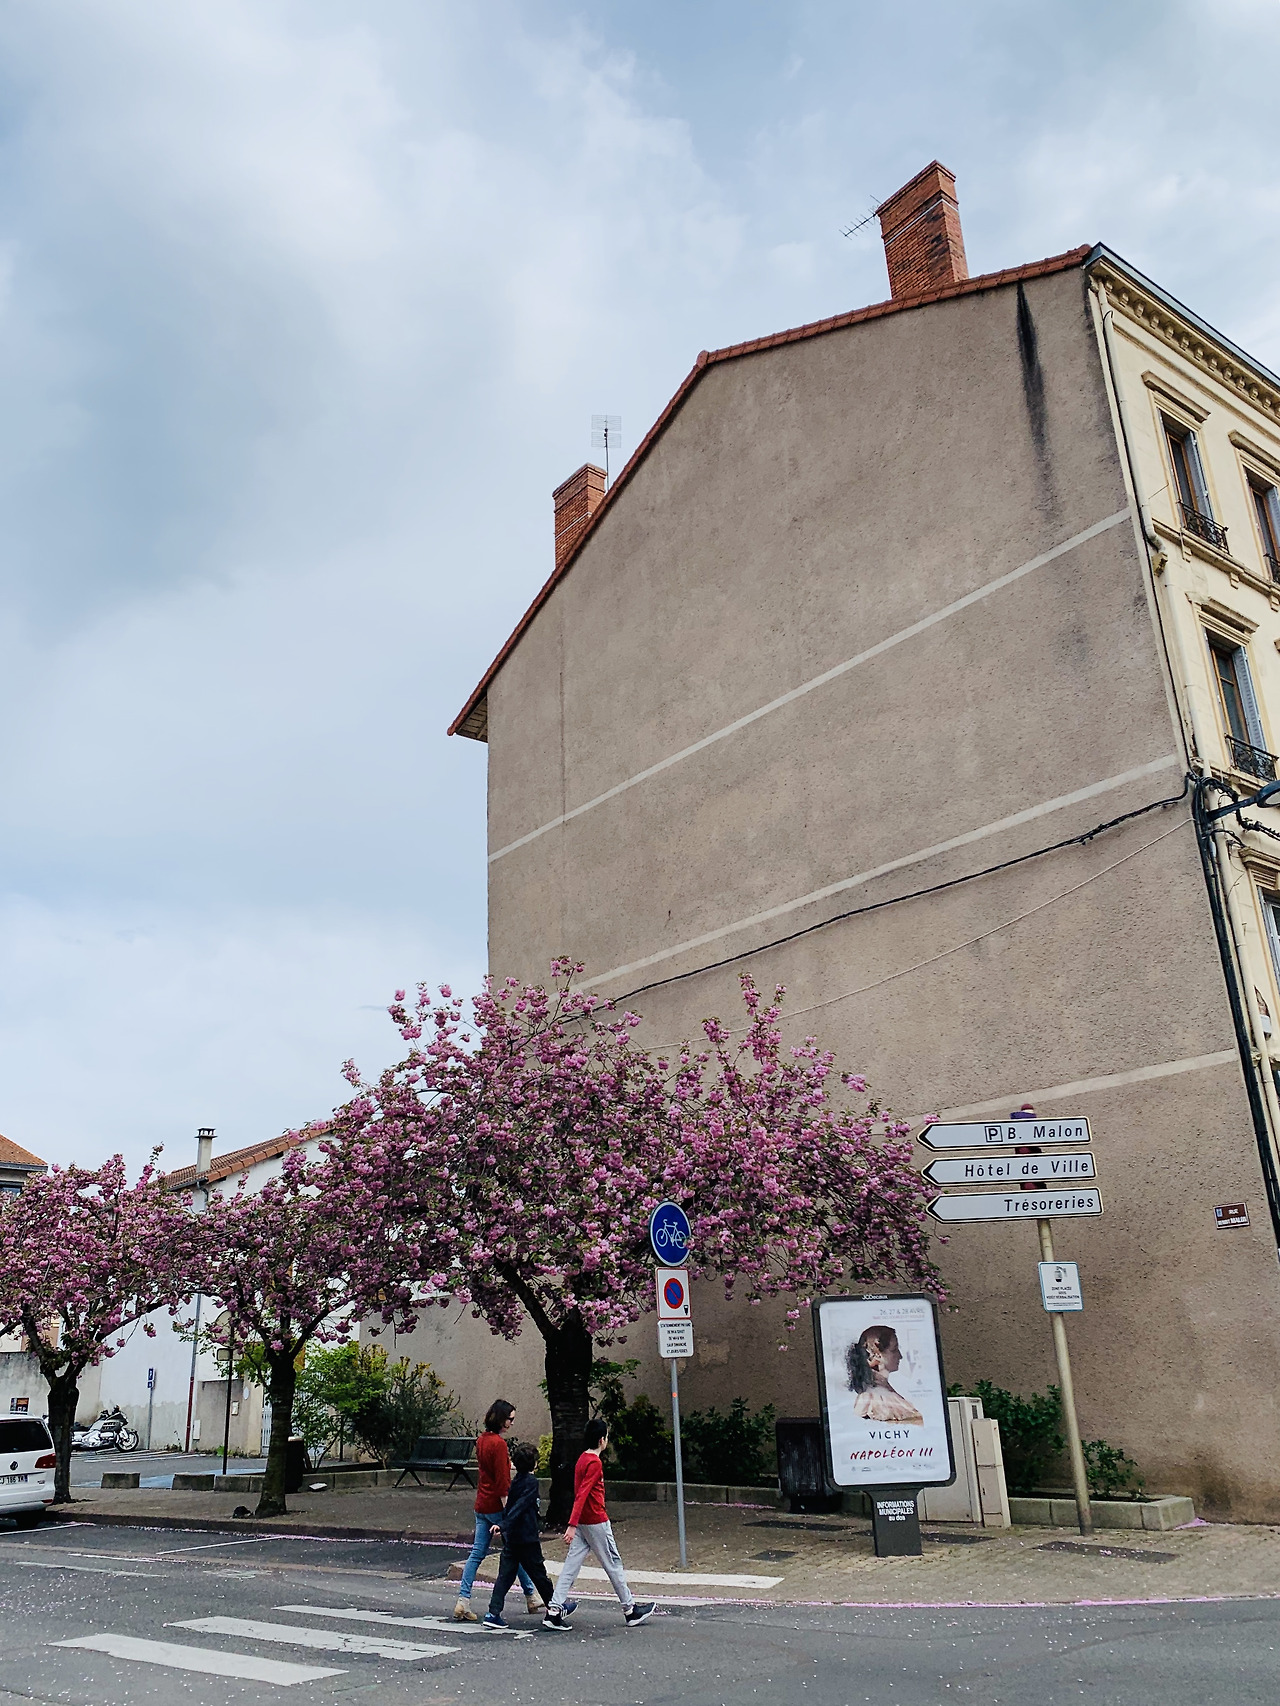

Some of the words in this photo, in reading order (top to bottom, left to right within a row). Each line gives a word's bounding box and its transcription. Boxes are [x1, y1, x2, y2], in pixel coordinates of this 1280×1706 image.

[988, 1127, 998, 1140] P
[1007, 1127, 1022, 1140] B.
[1033, 1125, 1083, 1139] Malon
[965, 1163, 1010, 1177] Hôtel
[1021, 1162, 1039, 1175] de
[1051, 1159, 1089, 1173] Ville
[1004, 1195, 1094, 1212] Trésoreries
[869, 1430, 910, 1439] VICHY
[850, 1446, 915, 1460] NAPOLÉON
[919, 1447, 933, 1457] III
[876, 1500, 915, 1509] INFORMATIONS
